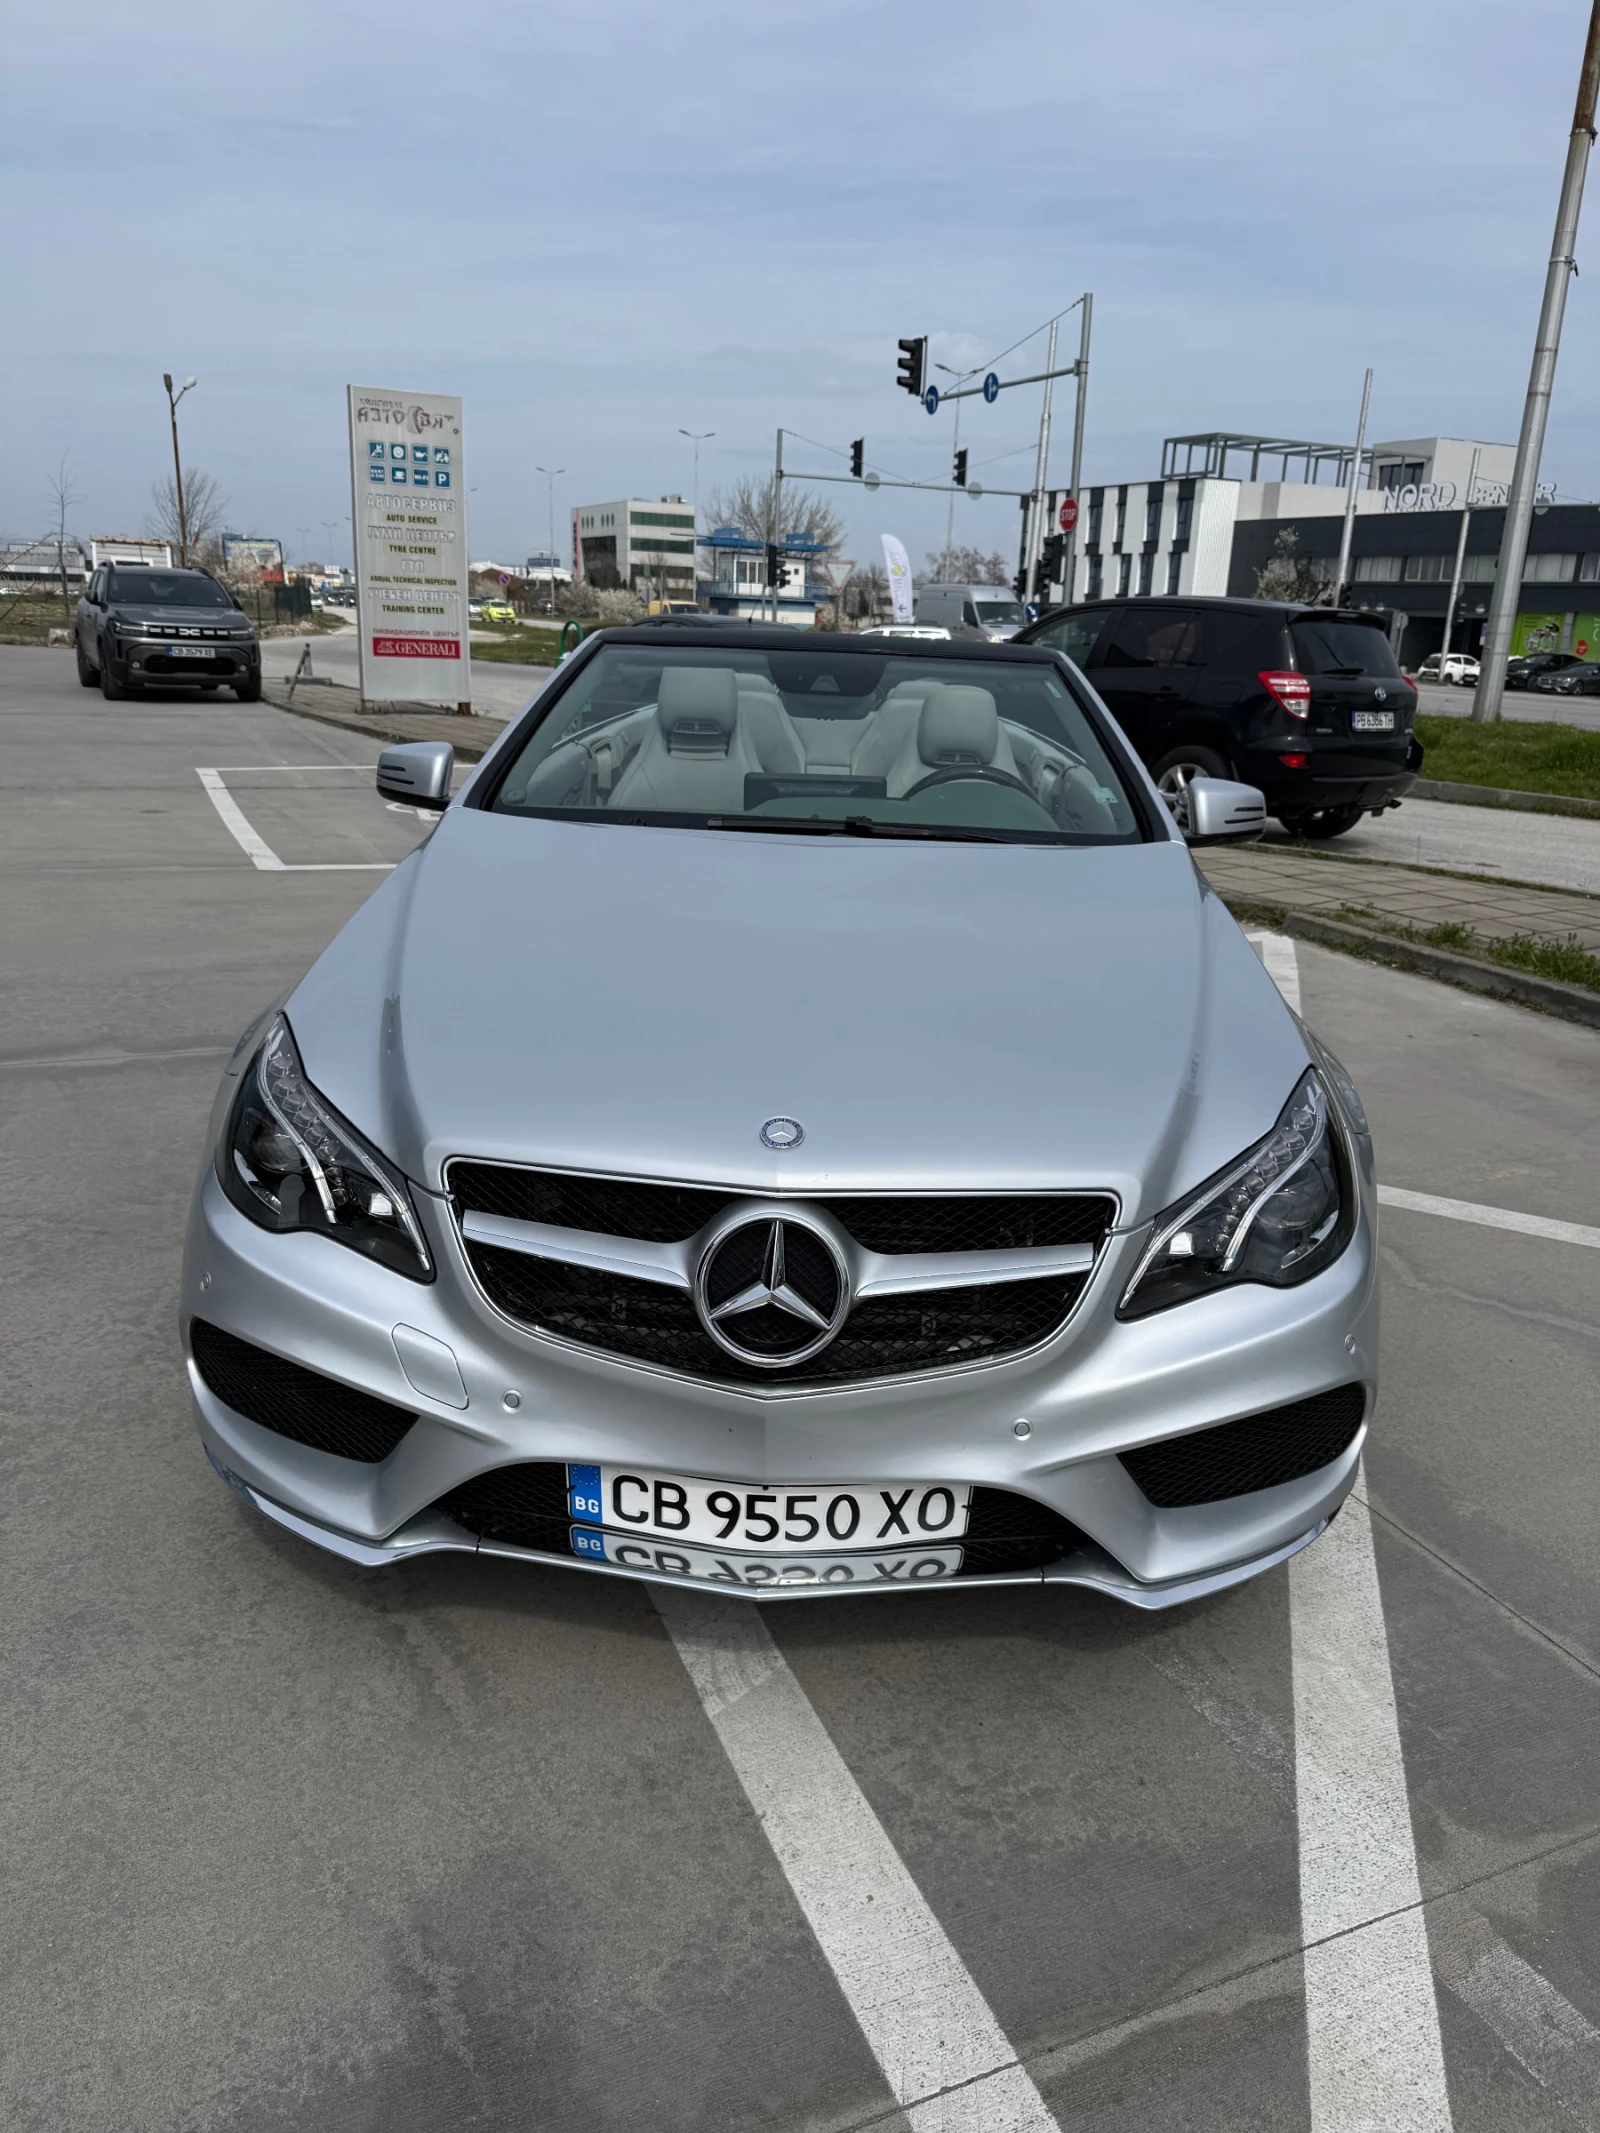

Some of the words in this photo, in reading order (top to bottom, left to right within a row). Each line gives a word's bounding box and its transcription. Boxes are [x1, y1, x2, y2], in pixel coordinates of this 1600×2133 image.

[367, 493, 456, 513] АВТОСЕРВИЗ
[1384, 482, 1456, 511] NORD
[386, 514, 405, 523] AUTO
[408, 515, 437, 525] SERVICE
[1061, 509, 1075, 521] STOP
[389, 545, 407, 553] TYRE
[409, 547, 436, 555] CENTRE
[367, 588, 411, 600] УЧЕБЕН
[415, 590, 460, 604] ЦЕНТЪР
[382, 605, 415, 613] TRAINING
[417, 607, 445, 615] CENTER
[395, 641, 457, 656] GENERALI
[575, 1496, 599, 1513] BG
[612, 1474, 690, 1531] CB
[706, 1490, 860, 1542] 9550
[876, 1487, 956, 1538] XO
